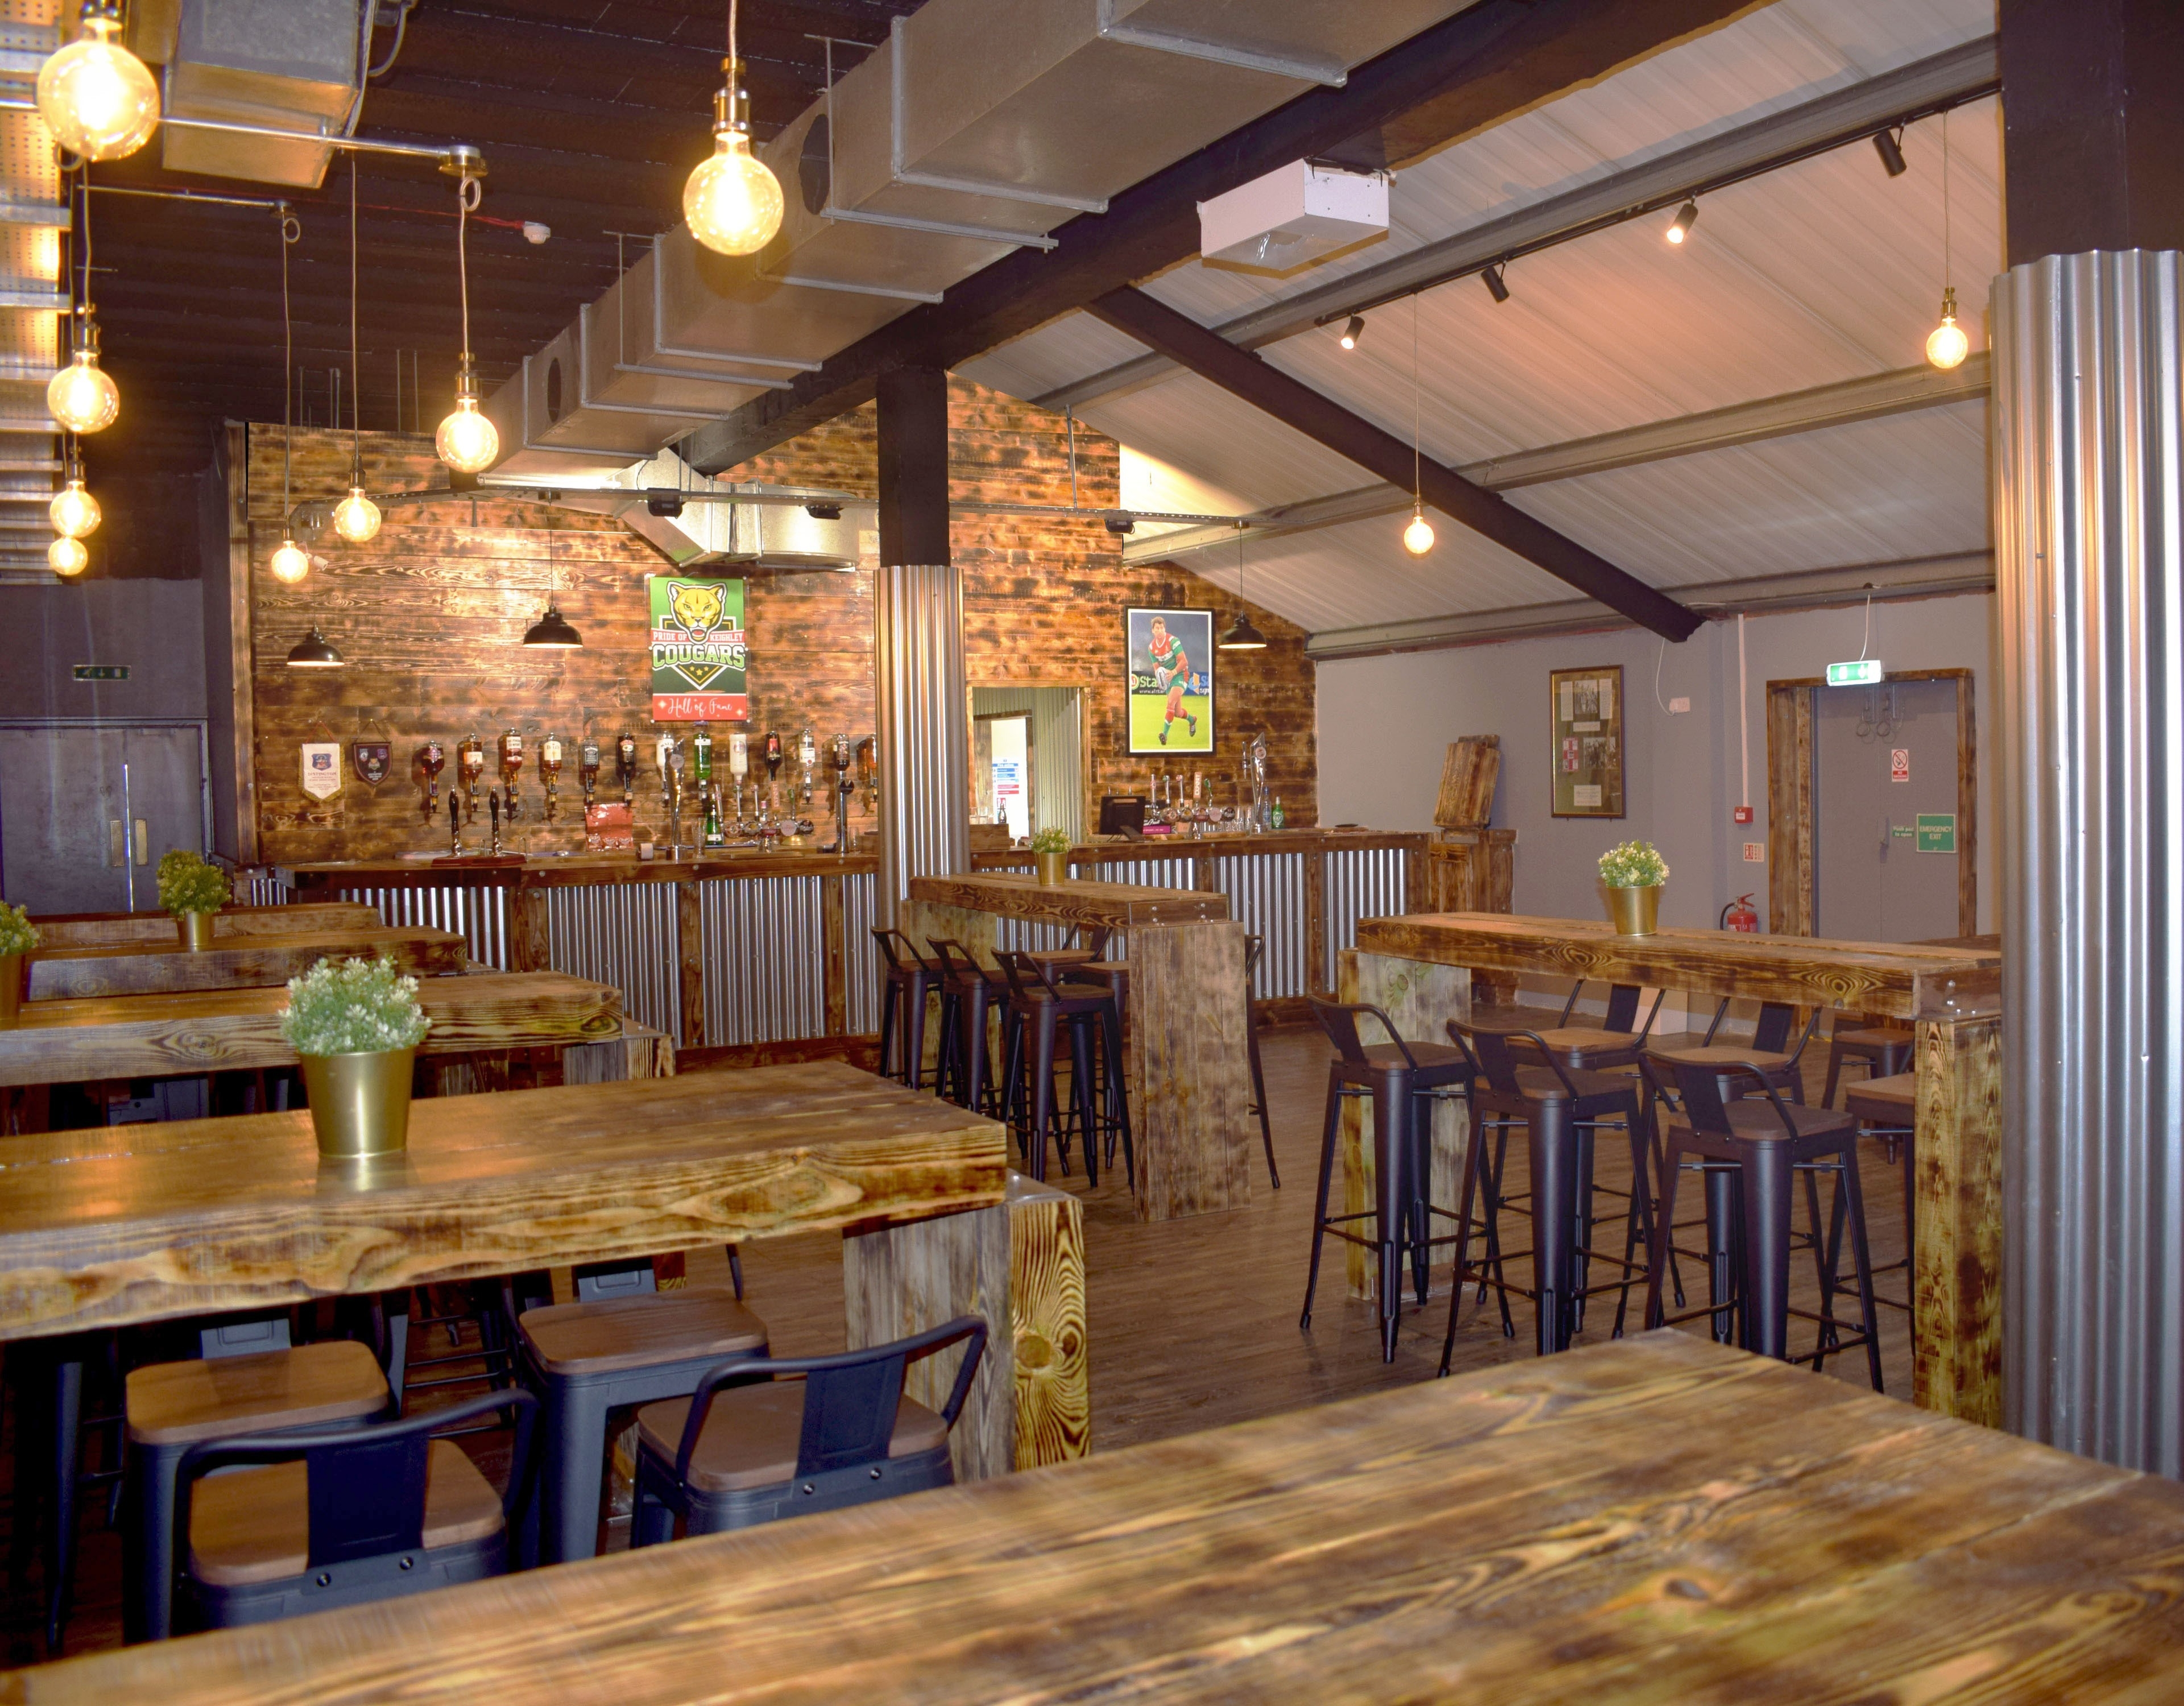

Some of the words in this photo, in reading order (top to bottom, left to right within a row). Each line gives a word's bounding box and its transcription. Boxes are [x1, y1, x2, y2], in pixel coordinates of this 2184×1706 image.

[653, 631, 676, 641] PRIDE
[677, 632, 688, 641] OF
[709, 632, 743, 642] KEIGHLEY
[652, 643, 746, 668] COUGARS
[668, 697, 693, 718] Hall
[694, 701, 707, 718] of
[709, 697, 733, 714] Fame
